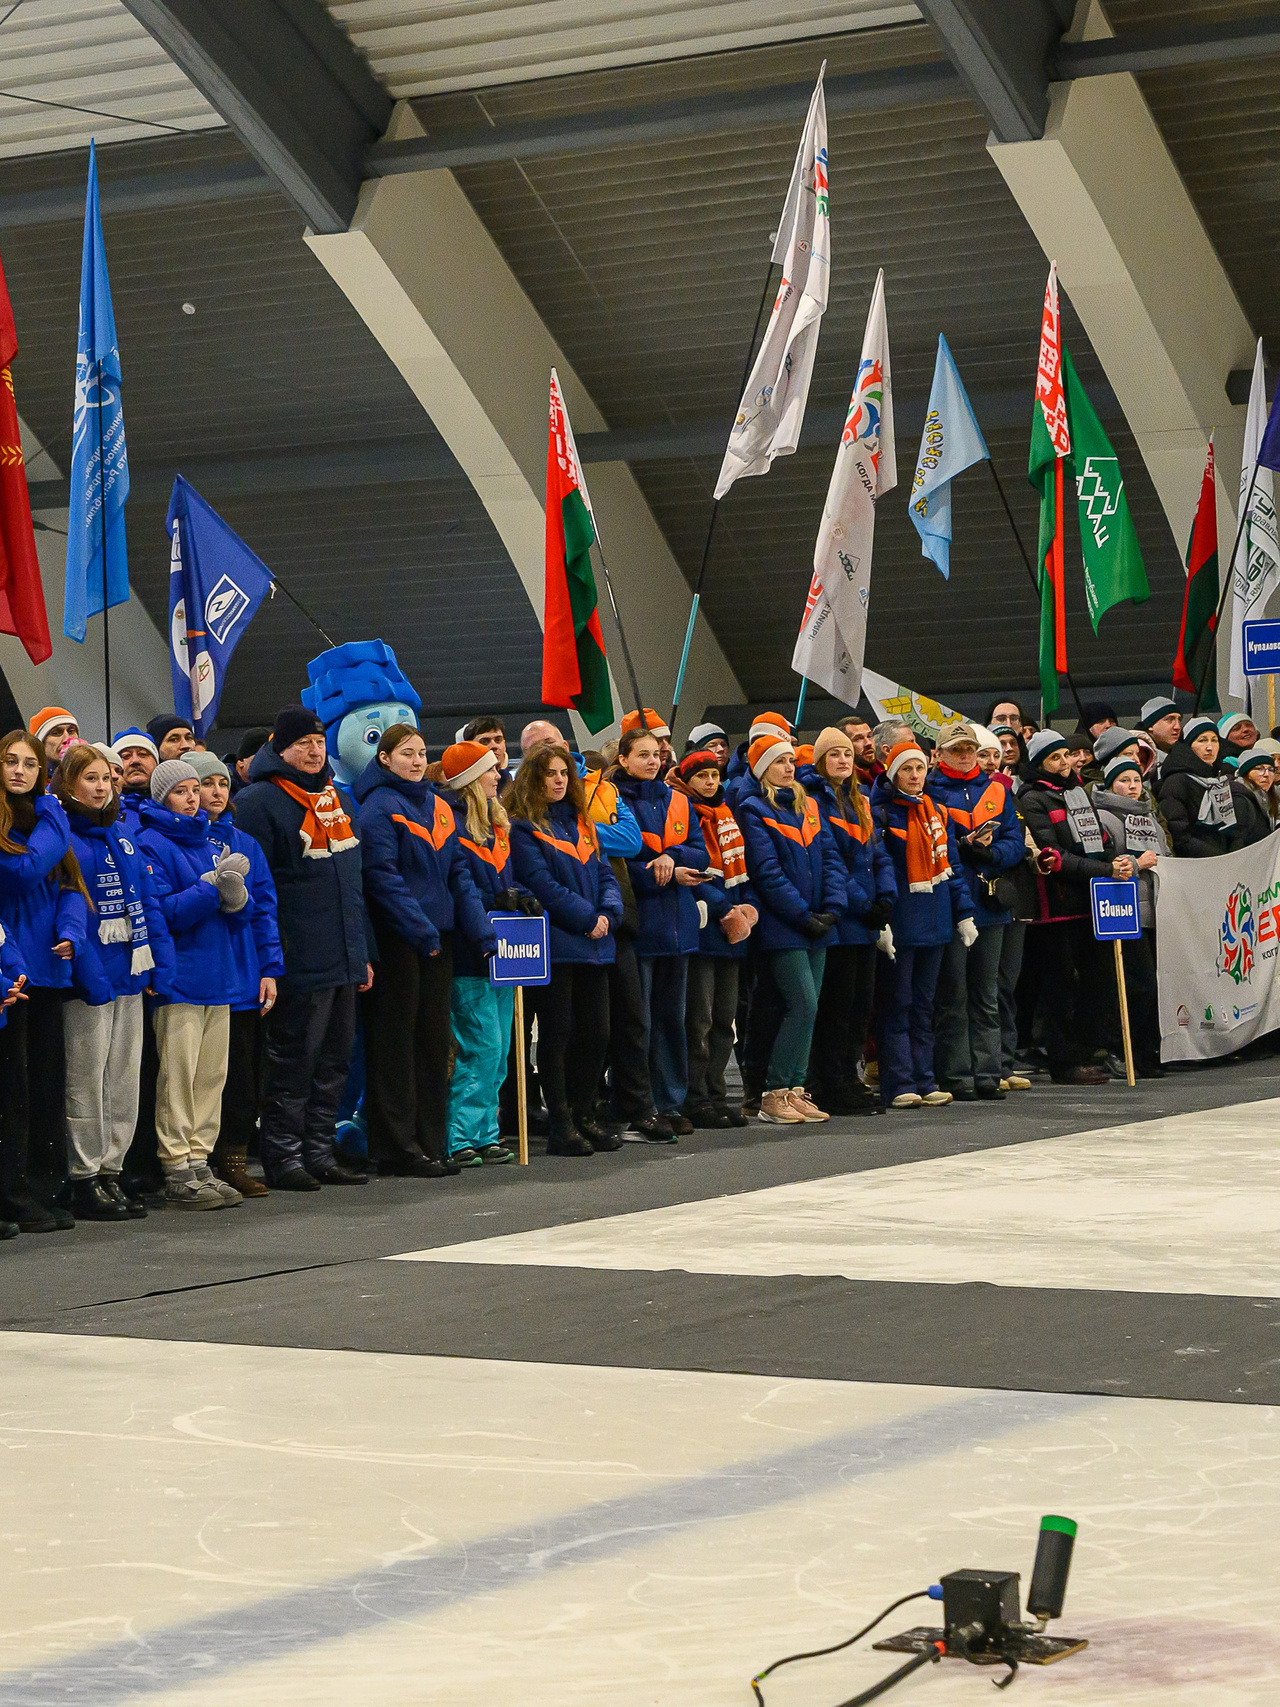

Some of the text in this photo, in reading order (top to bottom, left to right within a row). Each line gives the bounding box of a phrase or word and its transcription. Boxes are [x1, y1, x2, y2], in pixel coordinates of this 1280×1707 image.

[855, 461, 874, 493] КОГДА
[1099, 899, 1134, 918] Единые
[497, 938, 541, 959] Молния
